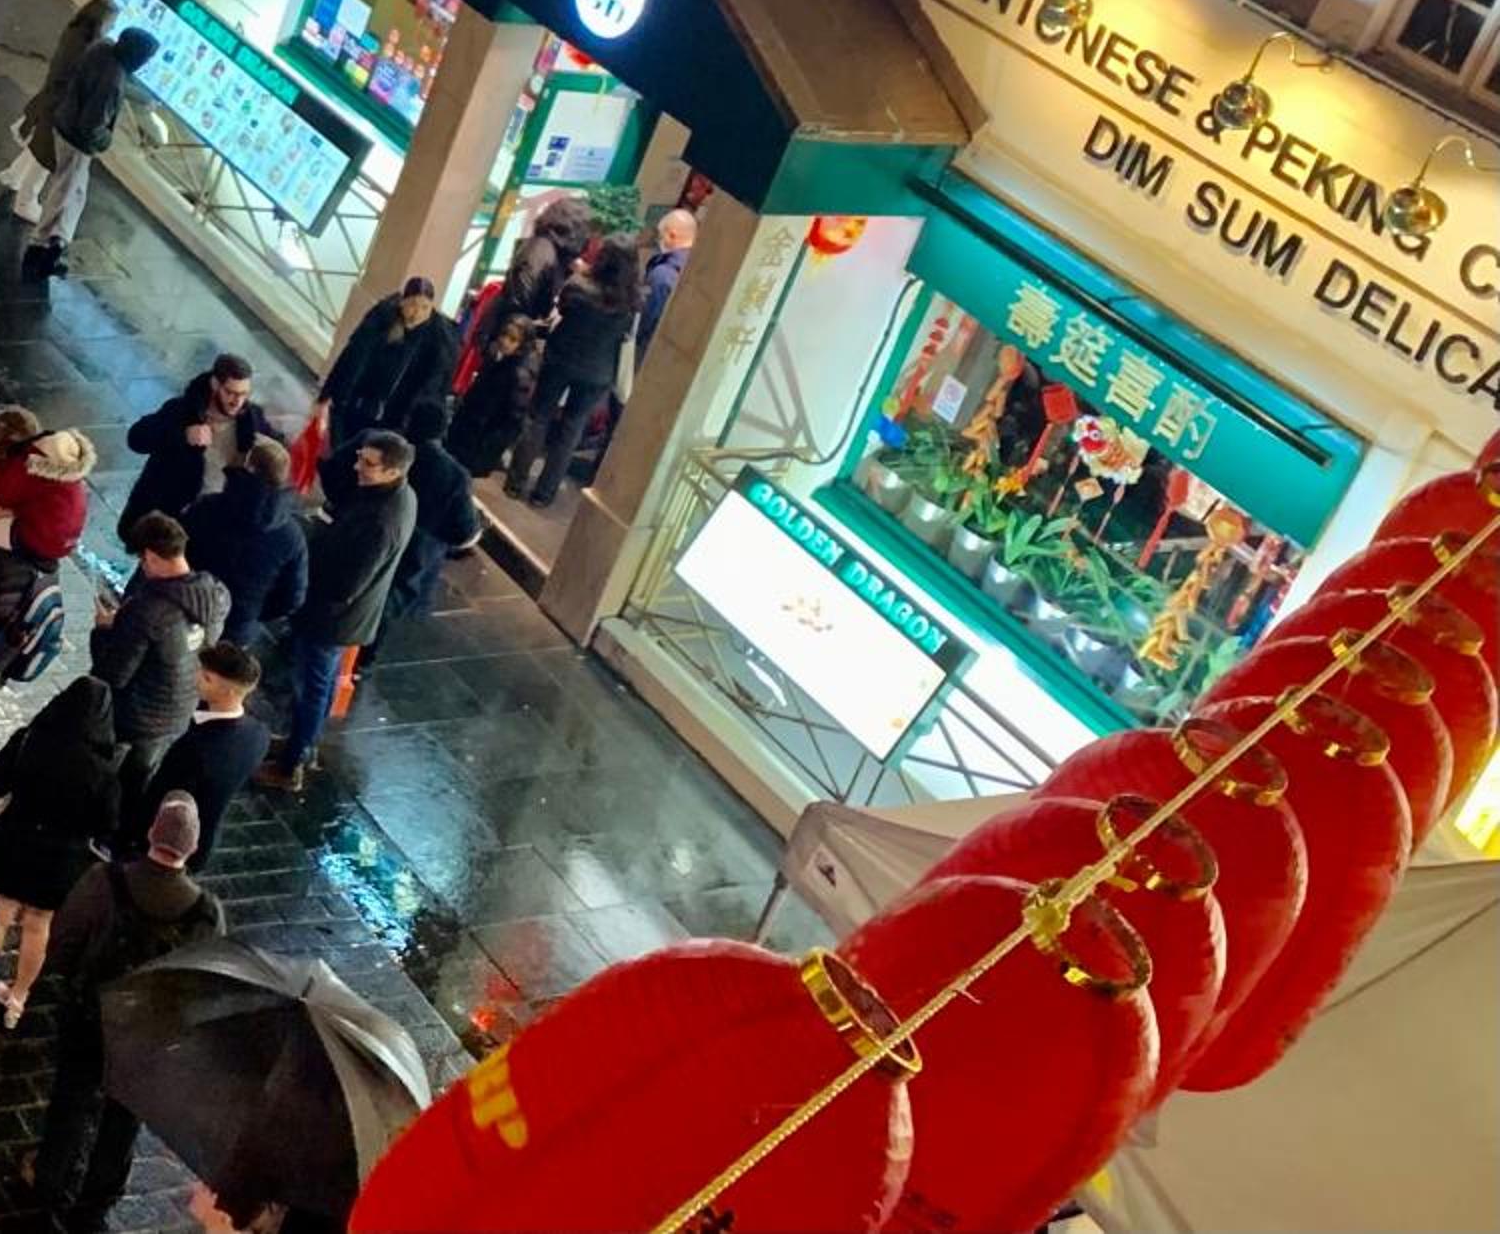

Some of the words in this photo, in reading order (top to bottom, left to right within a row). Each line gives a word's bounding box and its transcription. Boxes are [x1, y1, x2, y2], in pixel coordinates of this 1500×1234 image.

[1083, 114, 1176, 197] DIM
[1187, 180, 1305, 278] SUM
[750, 481, 846, 567] GOLDEN
[840, 560, 949, 656] DRAGON
